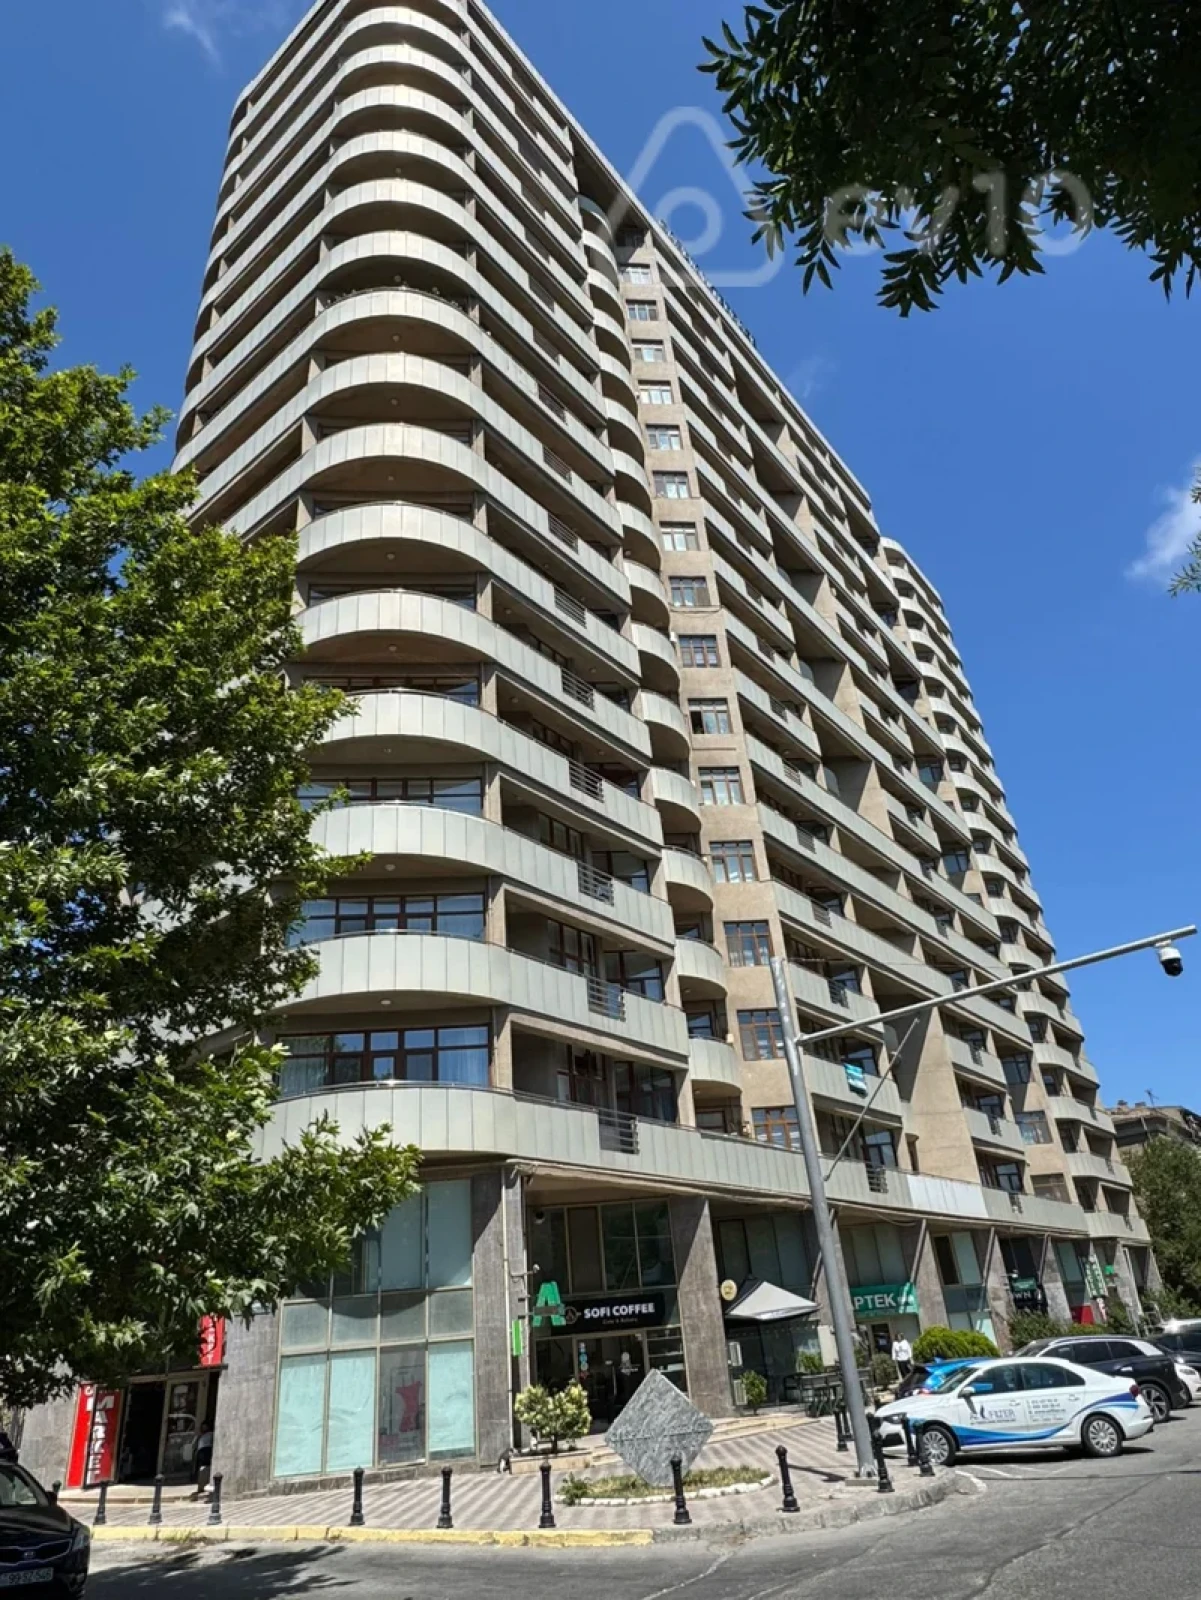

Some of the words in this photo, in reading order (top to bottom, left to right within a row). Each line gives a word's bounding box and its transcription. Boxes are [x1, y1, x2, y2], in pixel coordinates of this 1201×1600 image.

[853, 1293, 897, 1310] PTEK
[583, 1305, 611, 1319] SOFI
[612, 1302, 656, 1316] COFFEE
